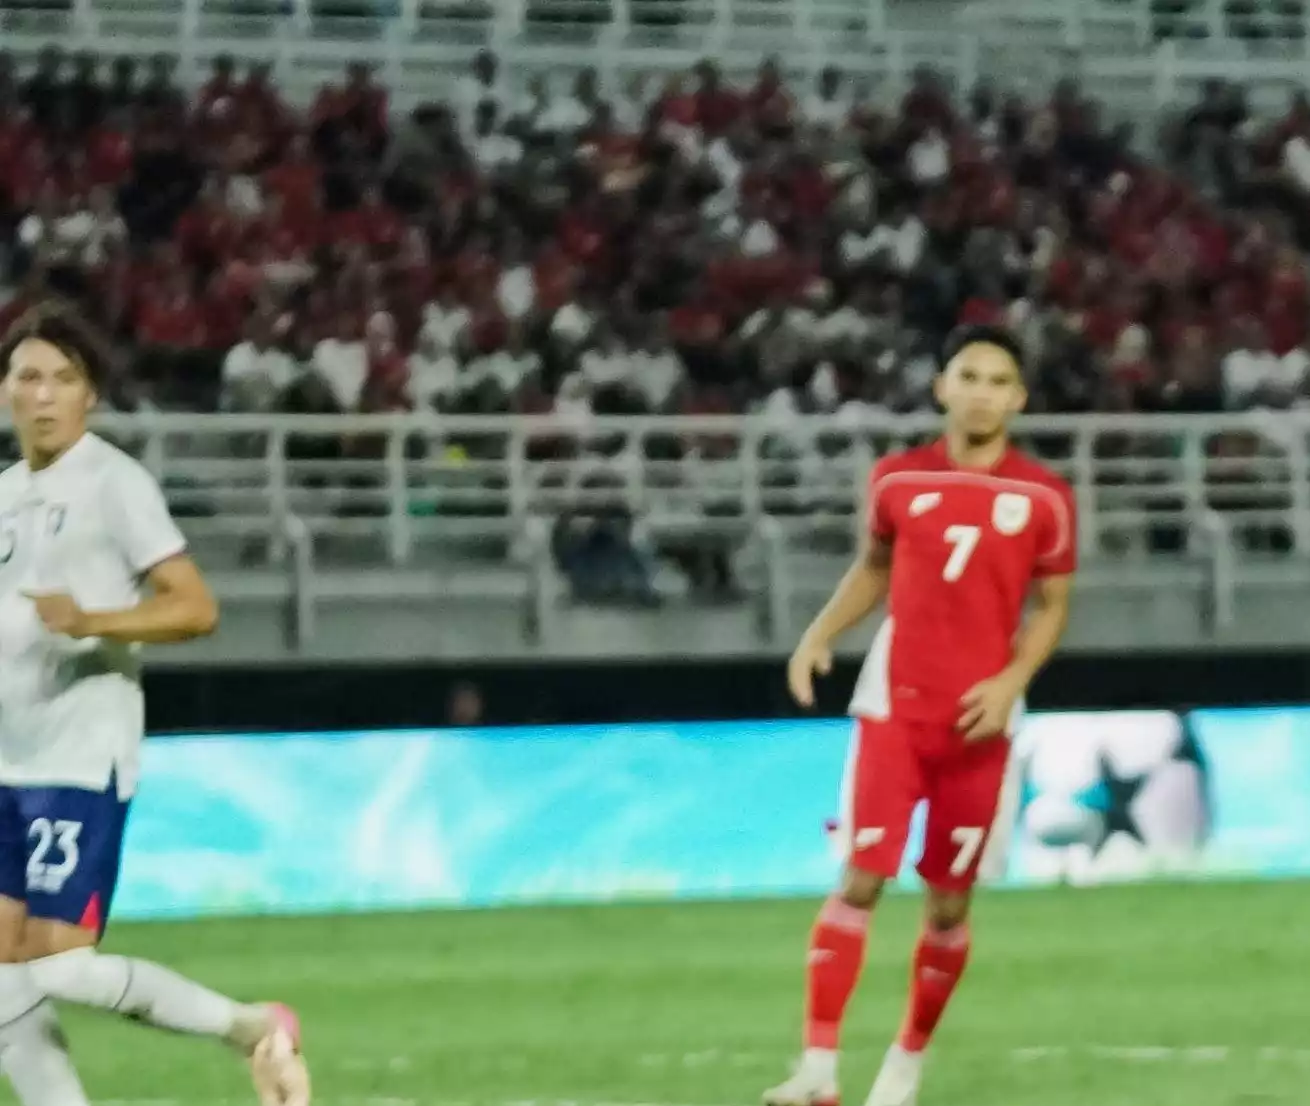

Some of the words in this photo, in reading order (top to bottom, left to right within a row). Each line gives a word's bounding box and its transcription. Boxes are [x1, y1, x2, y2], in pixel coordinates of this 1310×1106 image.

[942, 524, 981, 582] 7
[26, 817, 83, 876] 23
[950, 826, 984, 877] 7
